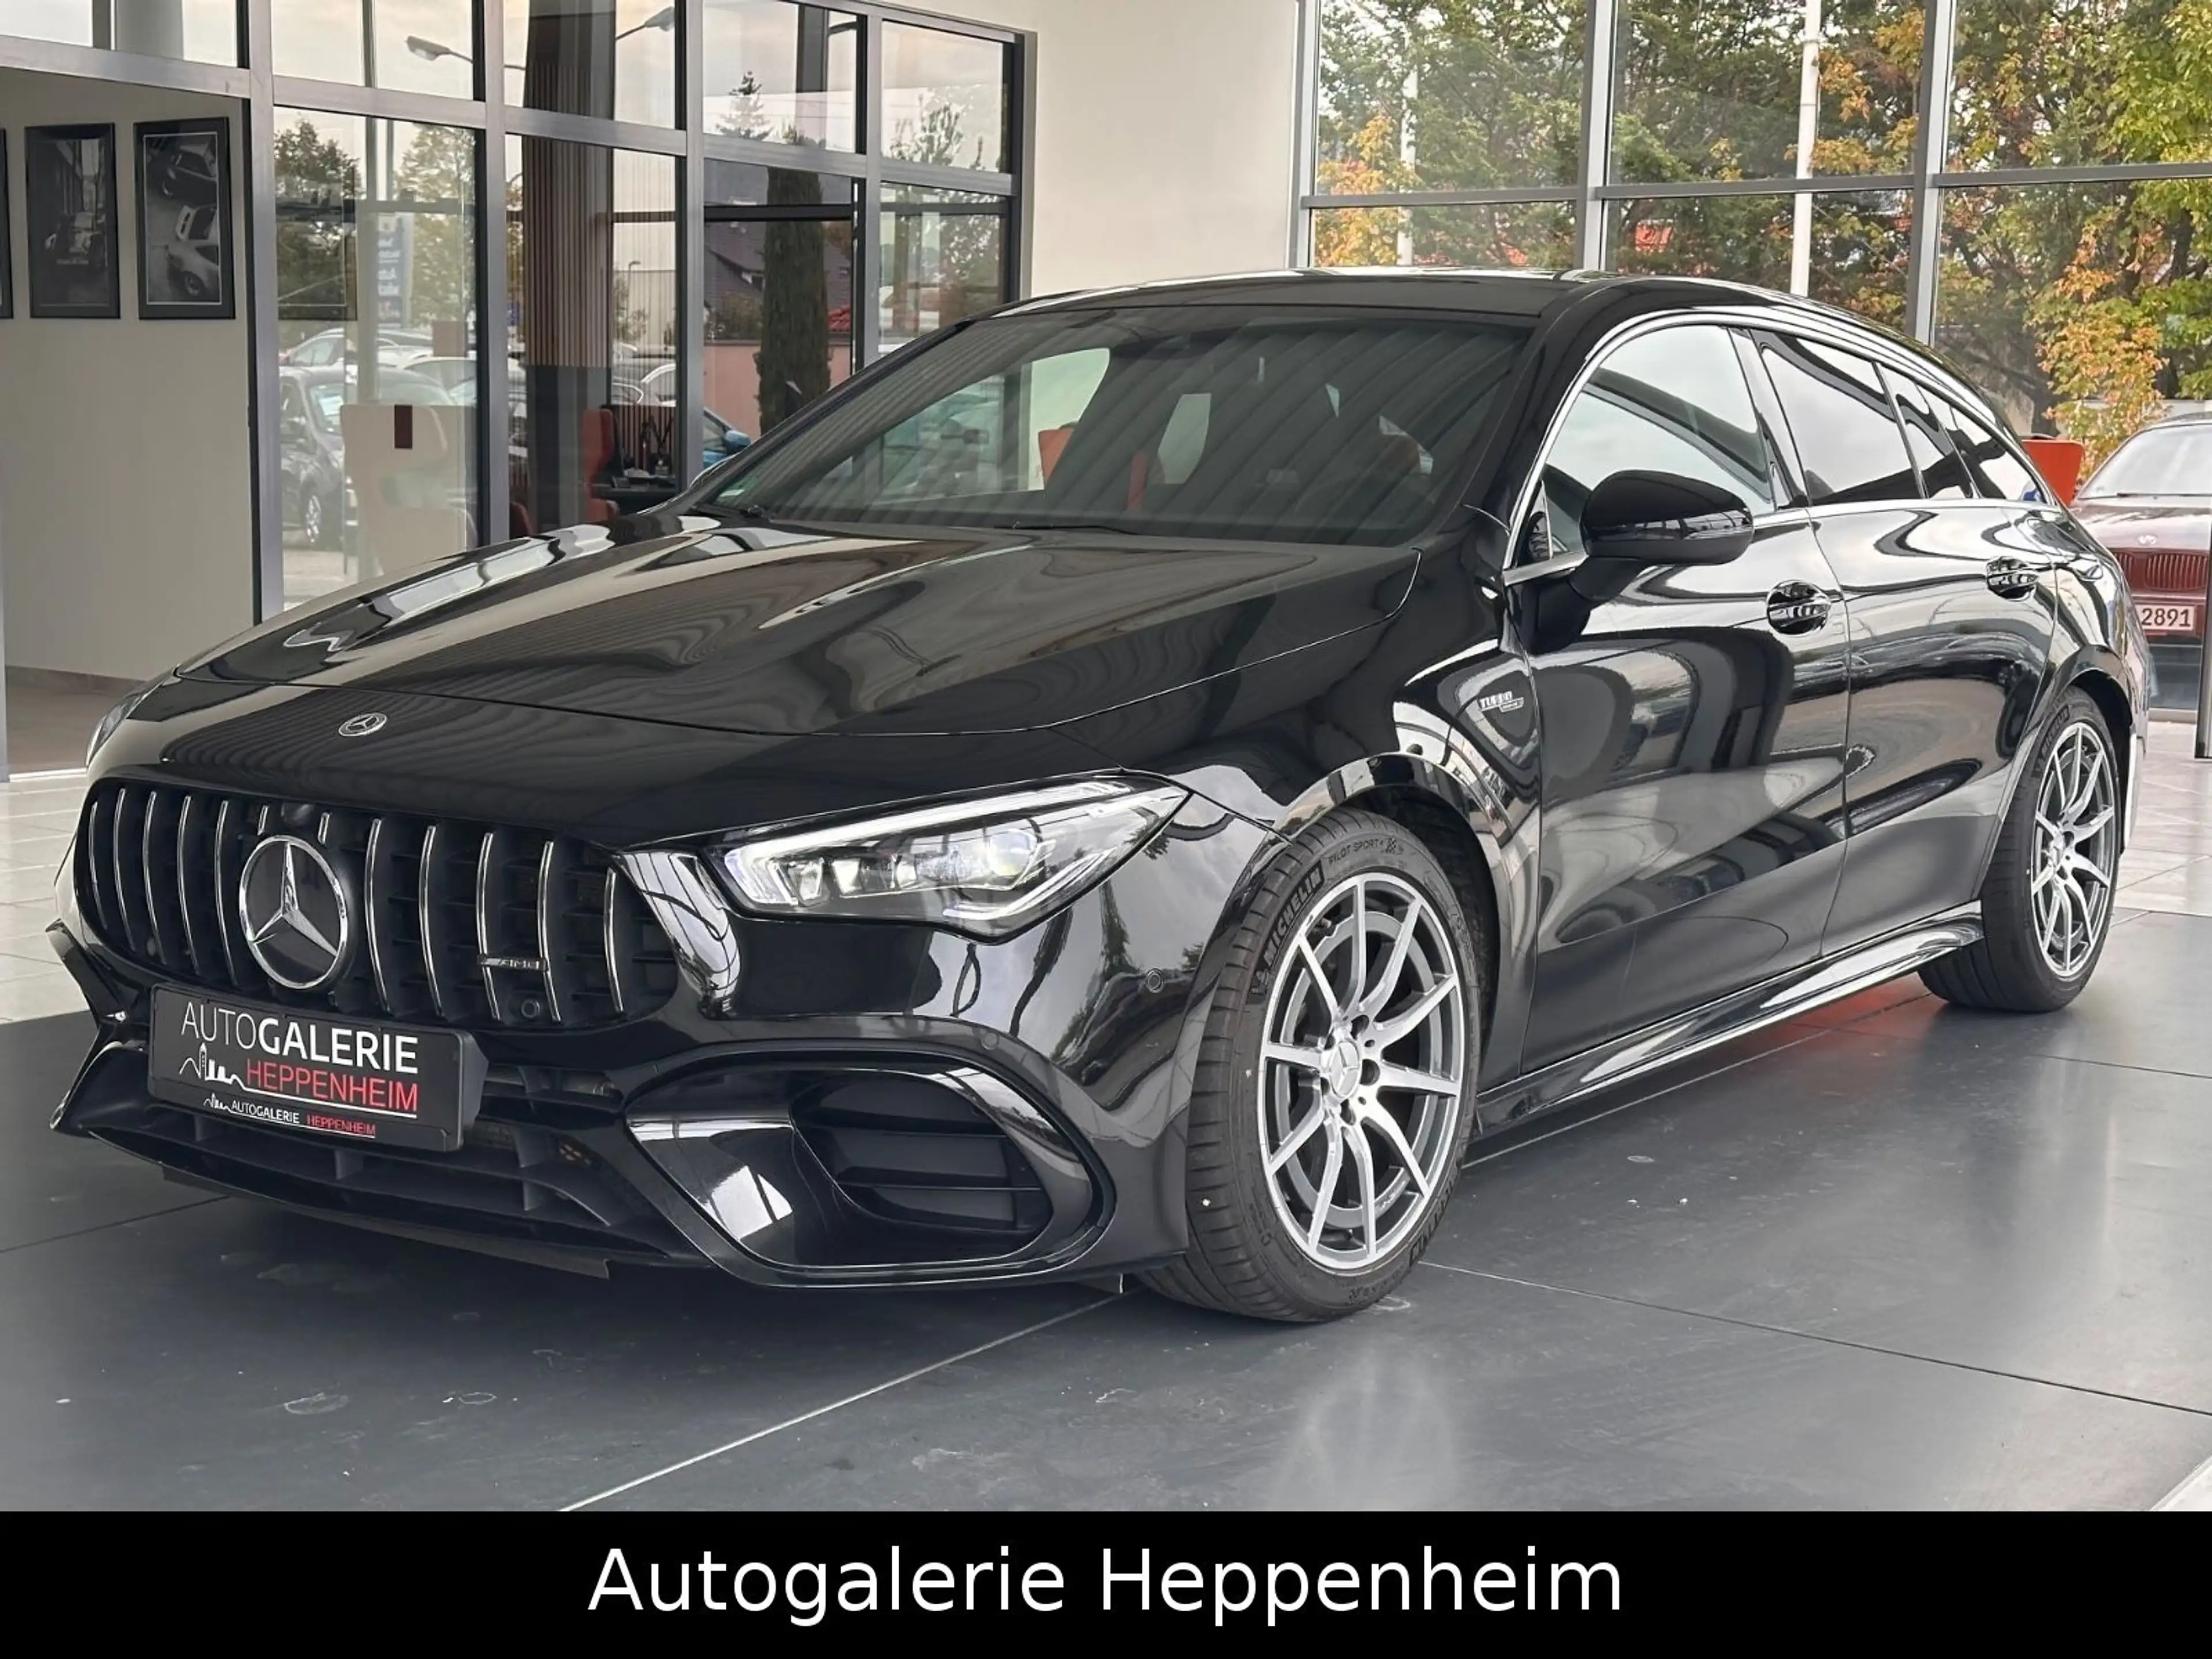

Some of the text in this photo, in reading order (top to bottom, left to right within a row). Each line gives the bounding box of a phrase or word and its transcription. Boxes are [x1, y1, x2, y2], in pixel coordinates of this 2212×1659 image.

[2141, 608, 2191, 627] 2891
[1263, 868, 1322, 967] MICHELIN
[181, 1001, 419, 1074] AUTOGALERIE
[246, 1058, 419, 1112] HEPPENHEIM
[231, 1099, 376, 1135] AUTOGALERIE HEPPENHEIM
